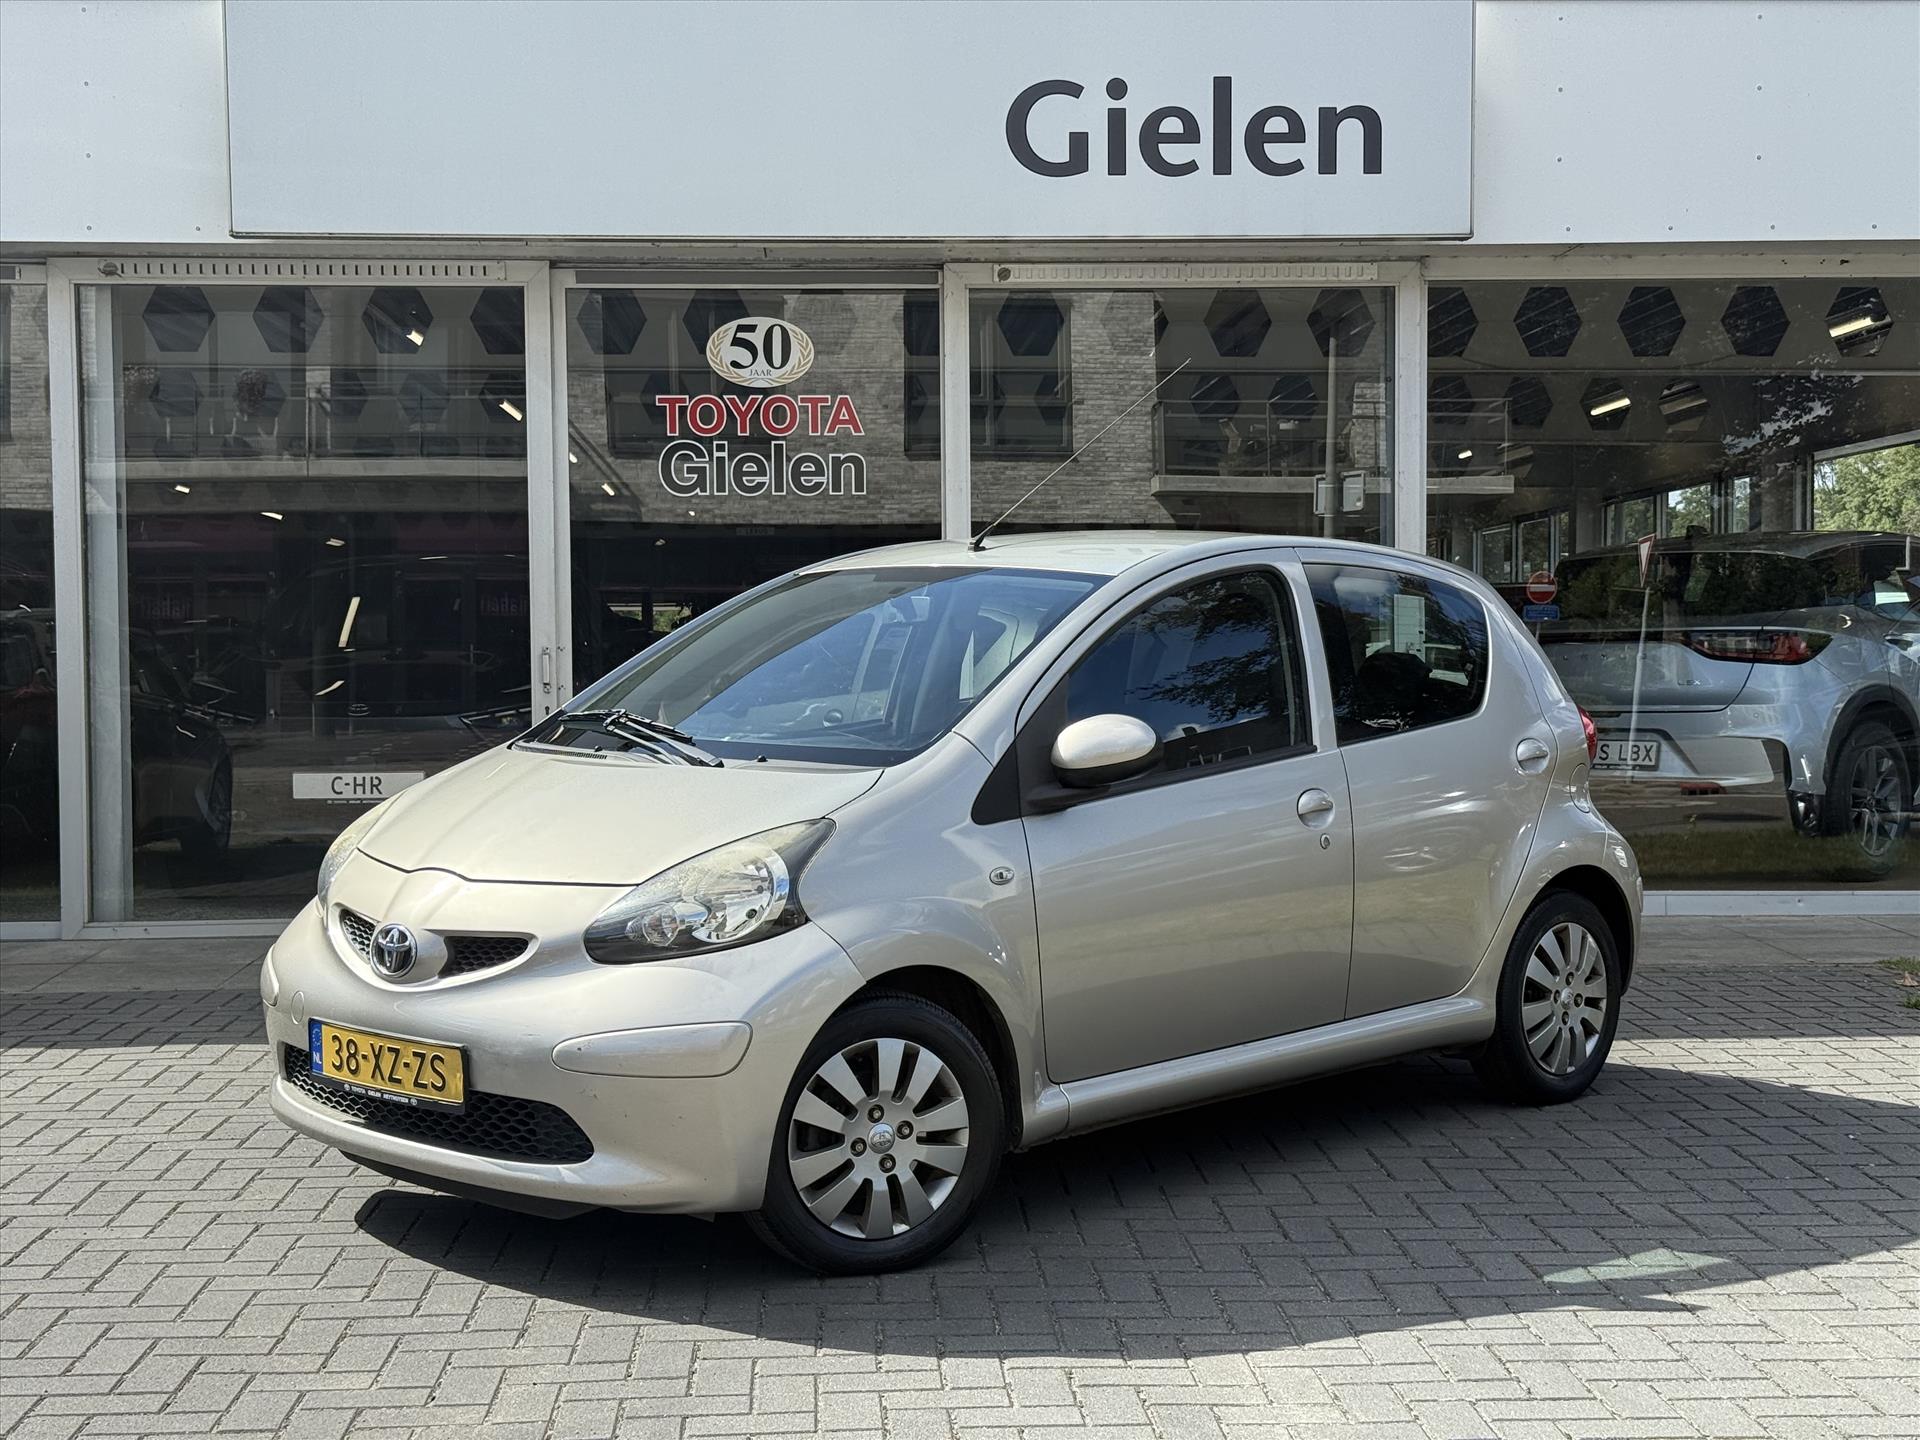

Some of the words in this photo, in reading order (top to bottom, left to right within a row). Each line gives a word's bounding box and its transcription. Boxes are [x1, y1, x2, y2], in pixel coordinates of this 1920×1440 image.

[1005, 75, 1382, 177] Gielen
[729, 323, 792, 370] 50
[748, 368, 773, 377] JAAR
[656, 394, 865, 437] TOYOTA
[658, 439, 867, 497] Gielen
[1618, 744, 1654, 762] LBX
[330, 775, 383, 795] C-HR
[312, 1051, 322, 1065] NL
[331, 1033, 447, 1093] 38-XZ-ZS
